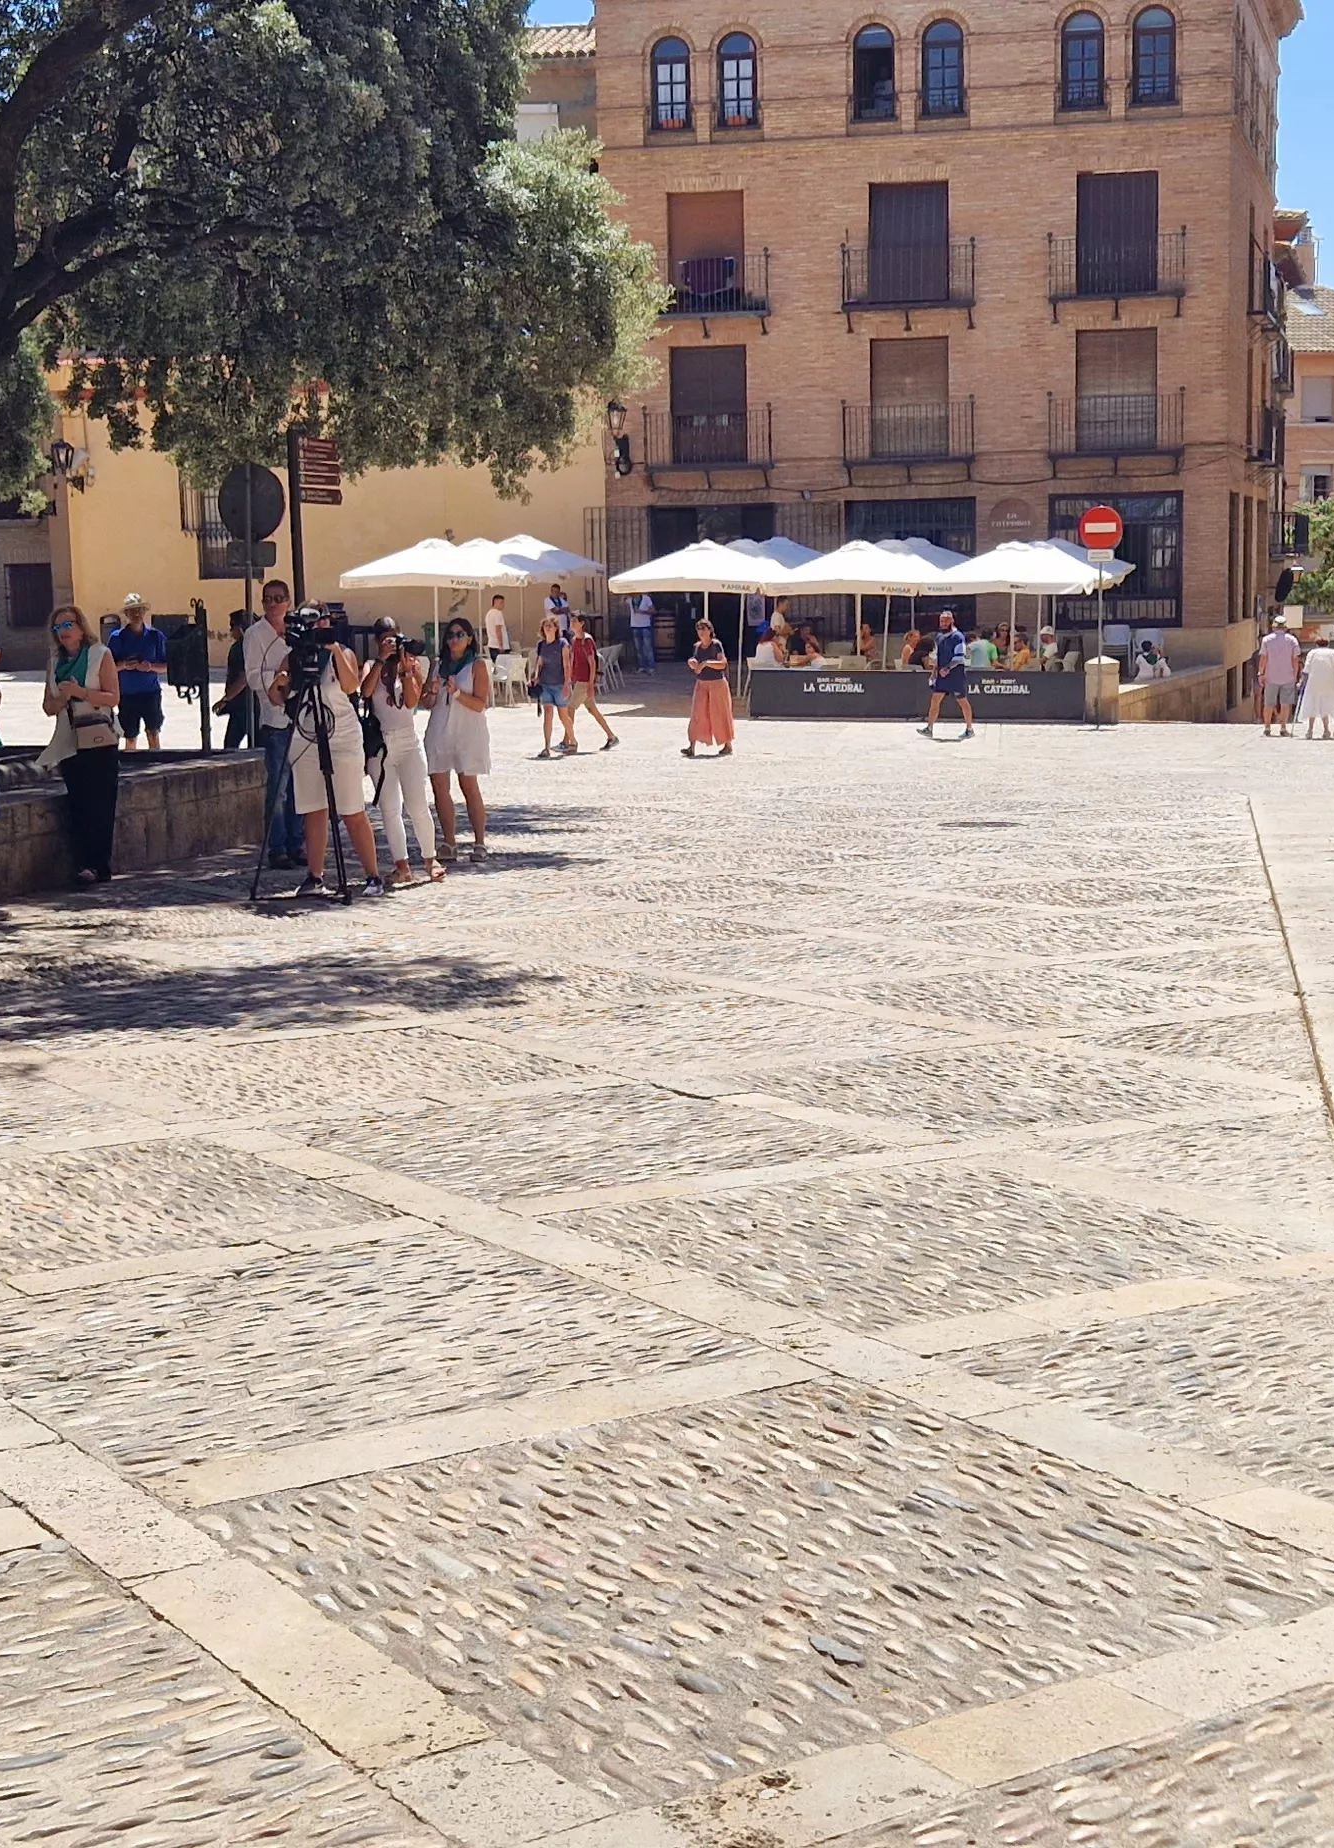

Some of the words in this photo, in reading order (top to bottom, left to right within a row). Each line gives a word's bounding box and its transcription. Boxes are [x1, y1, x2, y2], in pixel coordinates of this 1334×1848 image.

[803, 682, 816, 693] LA
[818, 683, 865, 693] CATEDRAL
[968, 684, 980, 694] LA
[983, 684, 1031, 694] CATEDRAL
